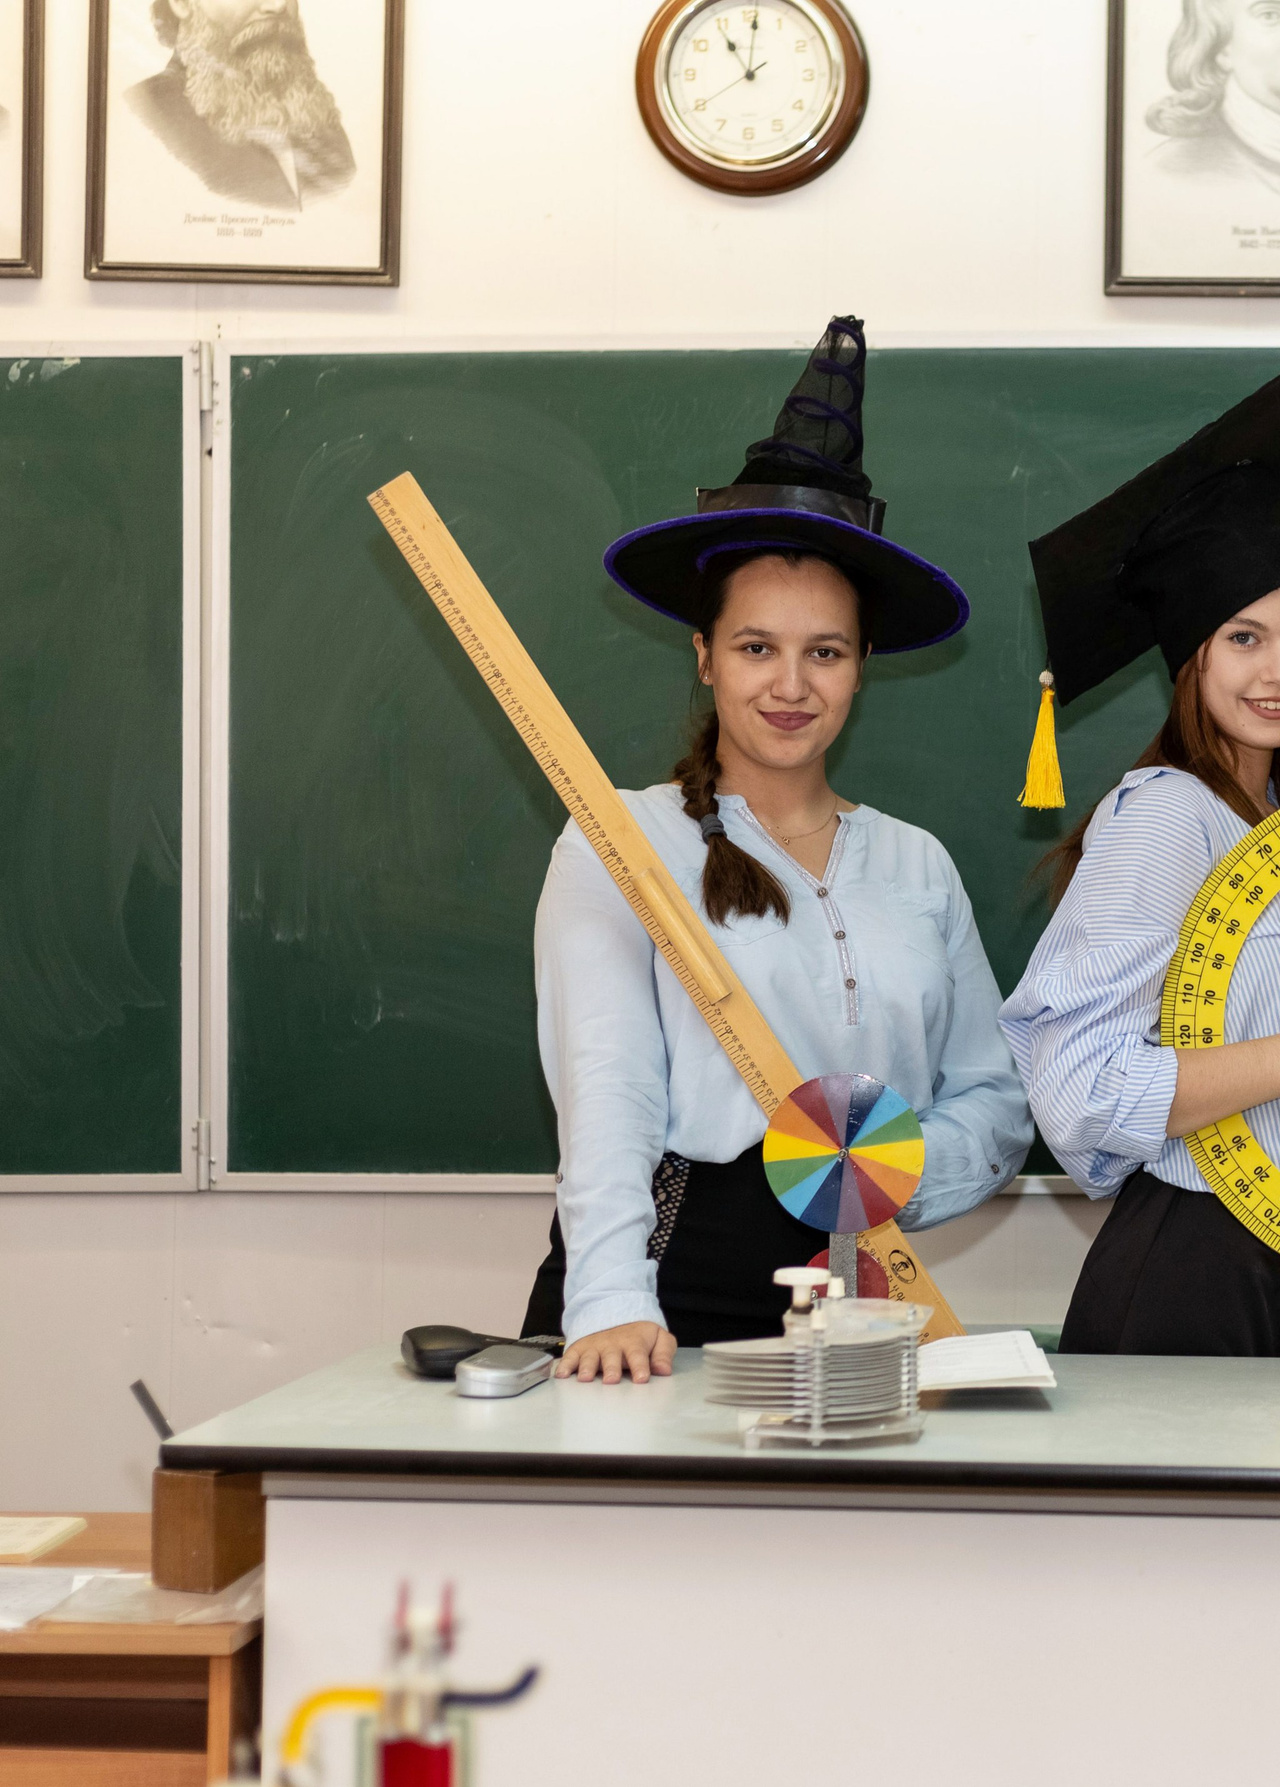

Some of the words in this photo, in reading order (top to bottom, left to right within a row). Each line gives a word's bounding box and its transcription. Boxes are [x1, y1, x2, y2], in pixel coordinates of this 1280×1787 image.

[742, 9, 758, 22] 12
[716, 18, 729, 30] 11
[777, 18, 783, 30] 1
[692, 39, 709, 53] 10
[795, 40, 807, 53] 2
[684, 68, 696, 81] 9
[802, 68, 815, 82] 3
[694, 99, 707, 112] 8
[792, 99, 804, 112] 4
[716, 119, 727, 131] 7
[771, 119, 784, 132] 5
[743, 127, 755, 140] 6
[1256, 844, 1272, 859] 70
[1229, 873, 1244, 890] 80
[1245, 885, 1263, 905] 100
[1206, 907, 1221, 924] 90
[1226, 919, 1240, 936] 90
[1190, 942, 1205, 963] 100
[1212, 953, 1225, 970] 80
[1182, 983, 1194, 1004] 110
[1204, 990, 1216, 1005] 70
[714, 1008, 722, 1016] 42
[720, 1017, 728, 1025] 41
[724, 1025, 733, 1034] 40
[1179, 1024, 1191, 1046] 120
[1202, 1027, 1213, 1044] 60
[731, 1034, 740, 1043] 39
[738, 1043, 746, 1052] 38
[743, 1053, 751, 1061] 37
[749, 1061, 757, 1070] 36
[755, 1070, 763, 1078] 35
[760, 1079, 769, 1088] 34
[766, 1088, 774, 1096] 33
[772, 1097, 780, 1106] 32
[1232, 1135, 1247, 1152] 30
[1211, 1144, 1228, 1165] 150
[1253, 1166, 1270, 1182] 20
[1235, 1178, 1253, 1198] 160
